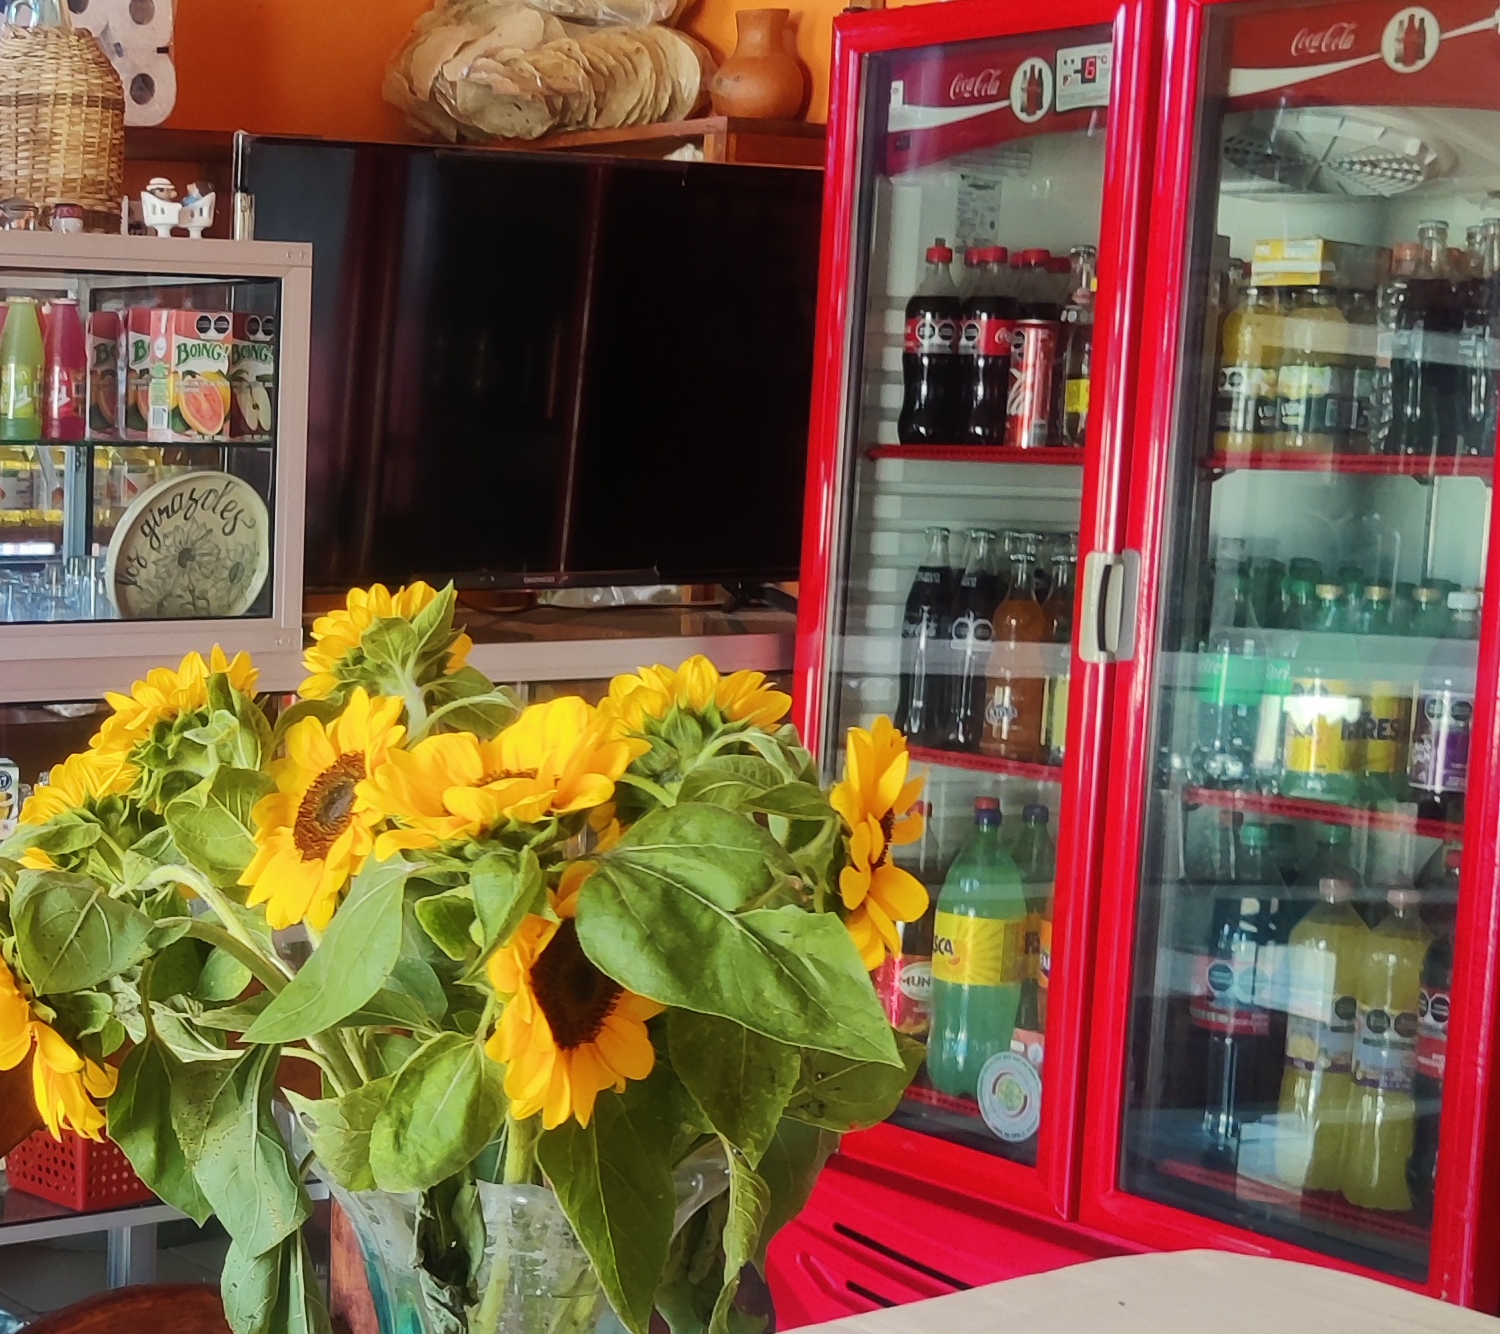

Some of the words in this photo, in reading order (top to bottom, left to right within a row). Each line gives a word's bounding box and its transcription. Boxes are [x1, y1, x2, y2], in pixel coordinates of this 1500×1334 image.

[176, 342, 230, 367] BOING!
[932, 934, 955, 956] SCA
[901, 975, 931, 988] MUN
